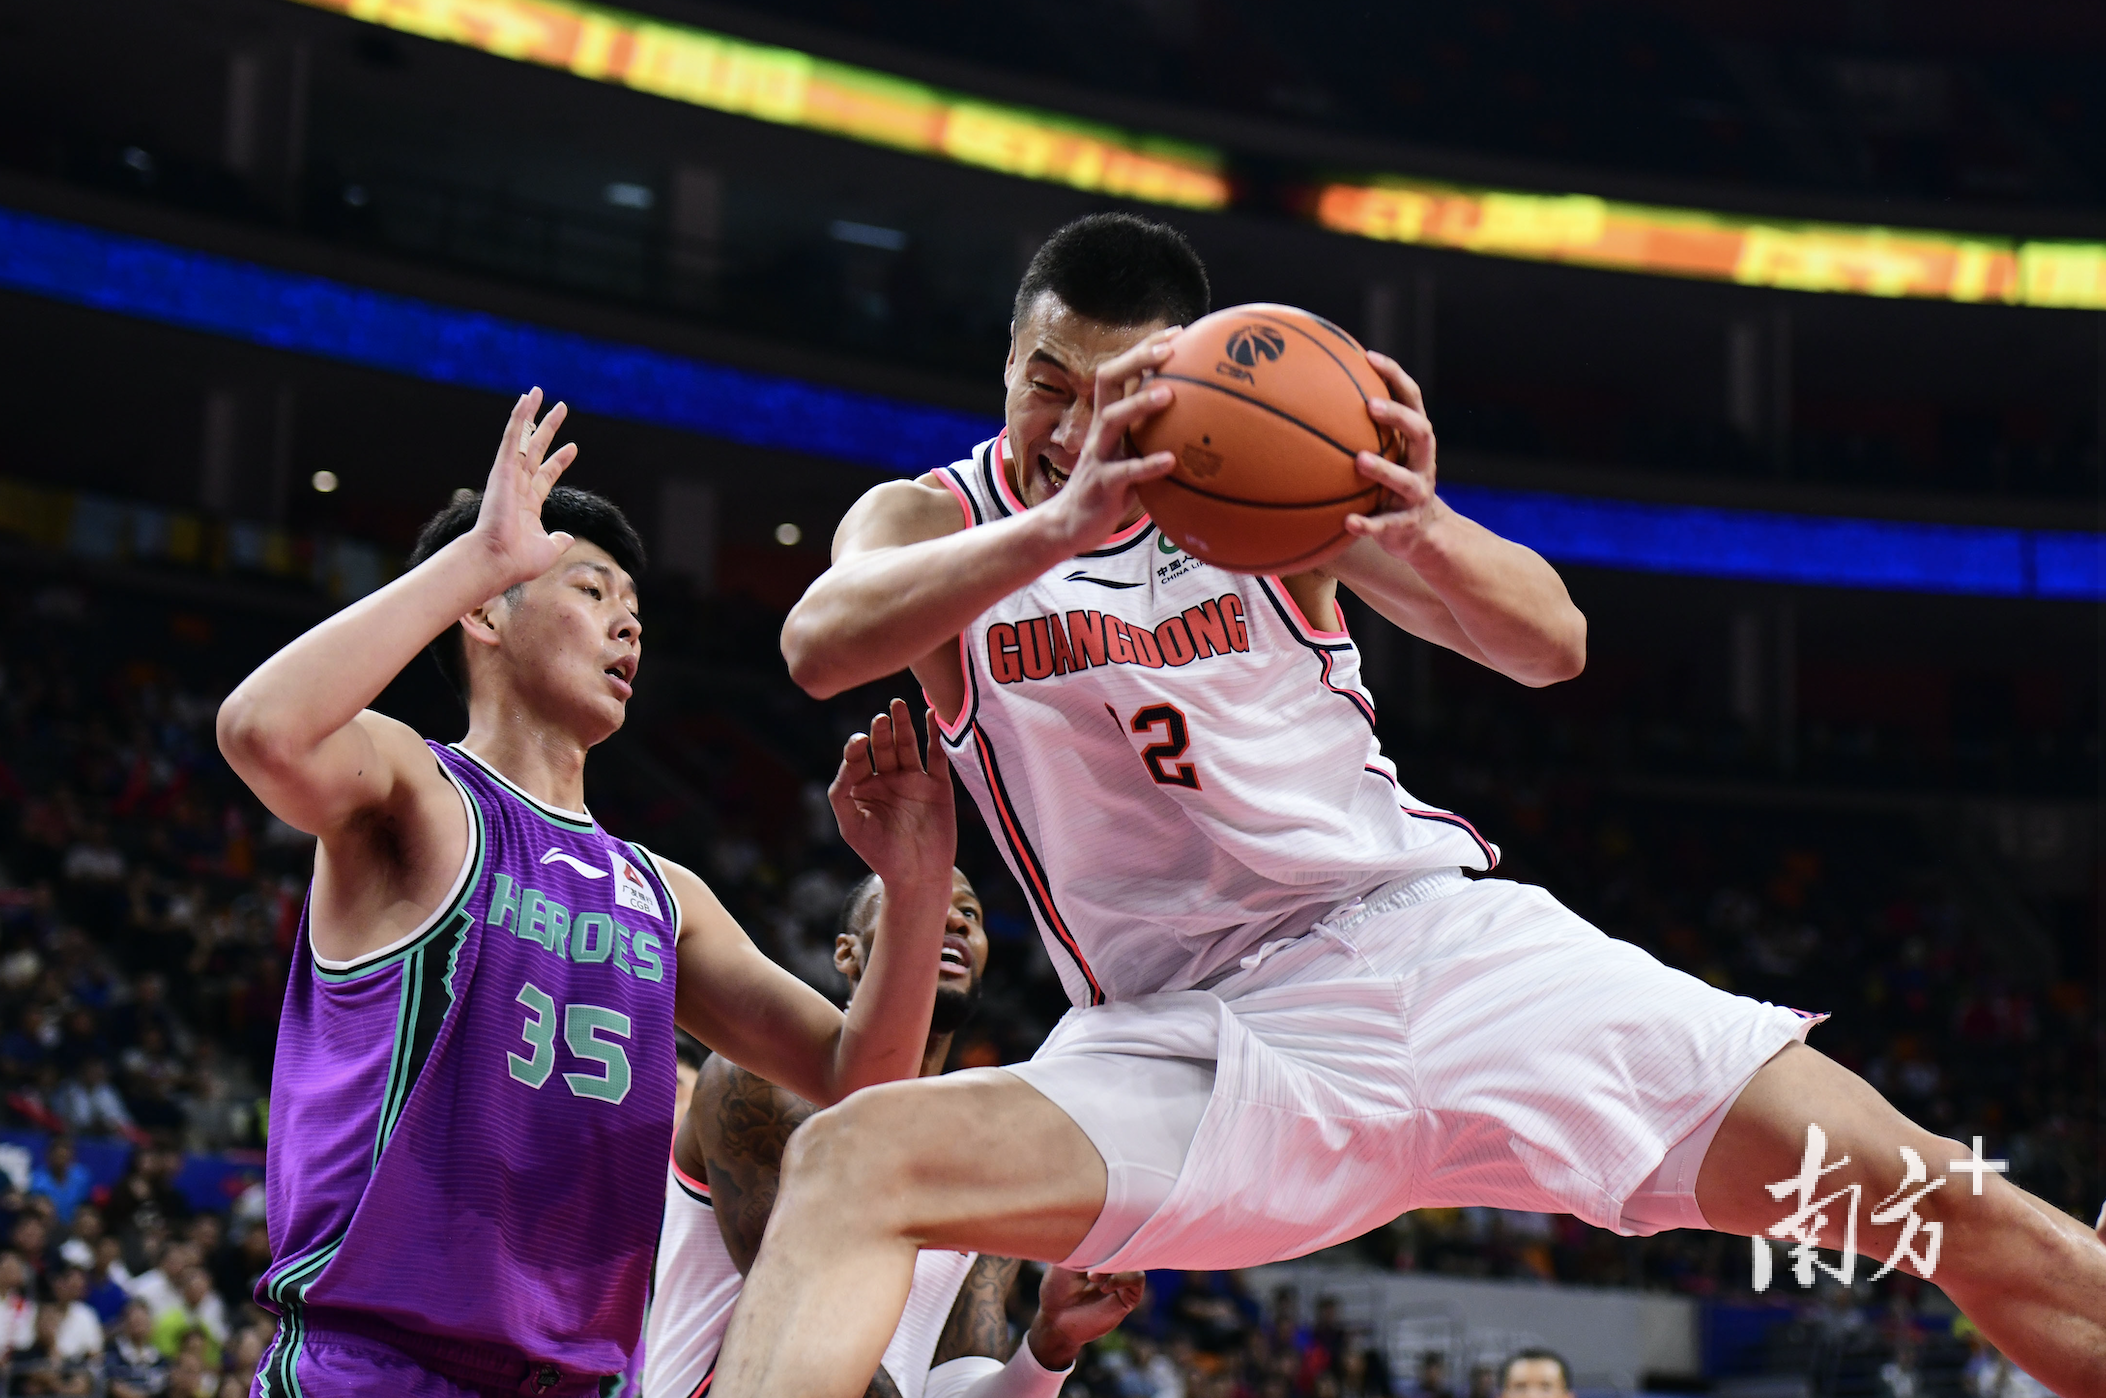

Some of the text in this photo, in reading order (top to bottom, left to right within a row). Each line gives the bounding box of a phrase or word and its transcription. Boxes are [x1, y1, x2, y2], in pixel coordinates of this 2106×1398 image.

[1161, 560, 1209, 585] CHINA LIF
[986, 593, 1250, 684] GUANGDONG
[1104, 702, 1203, 791] 2
[486, 873, 664, 983] HEROES
[630, 898, 651, 913] CGB
[506, 981, 632, 1106] 35
